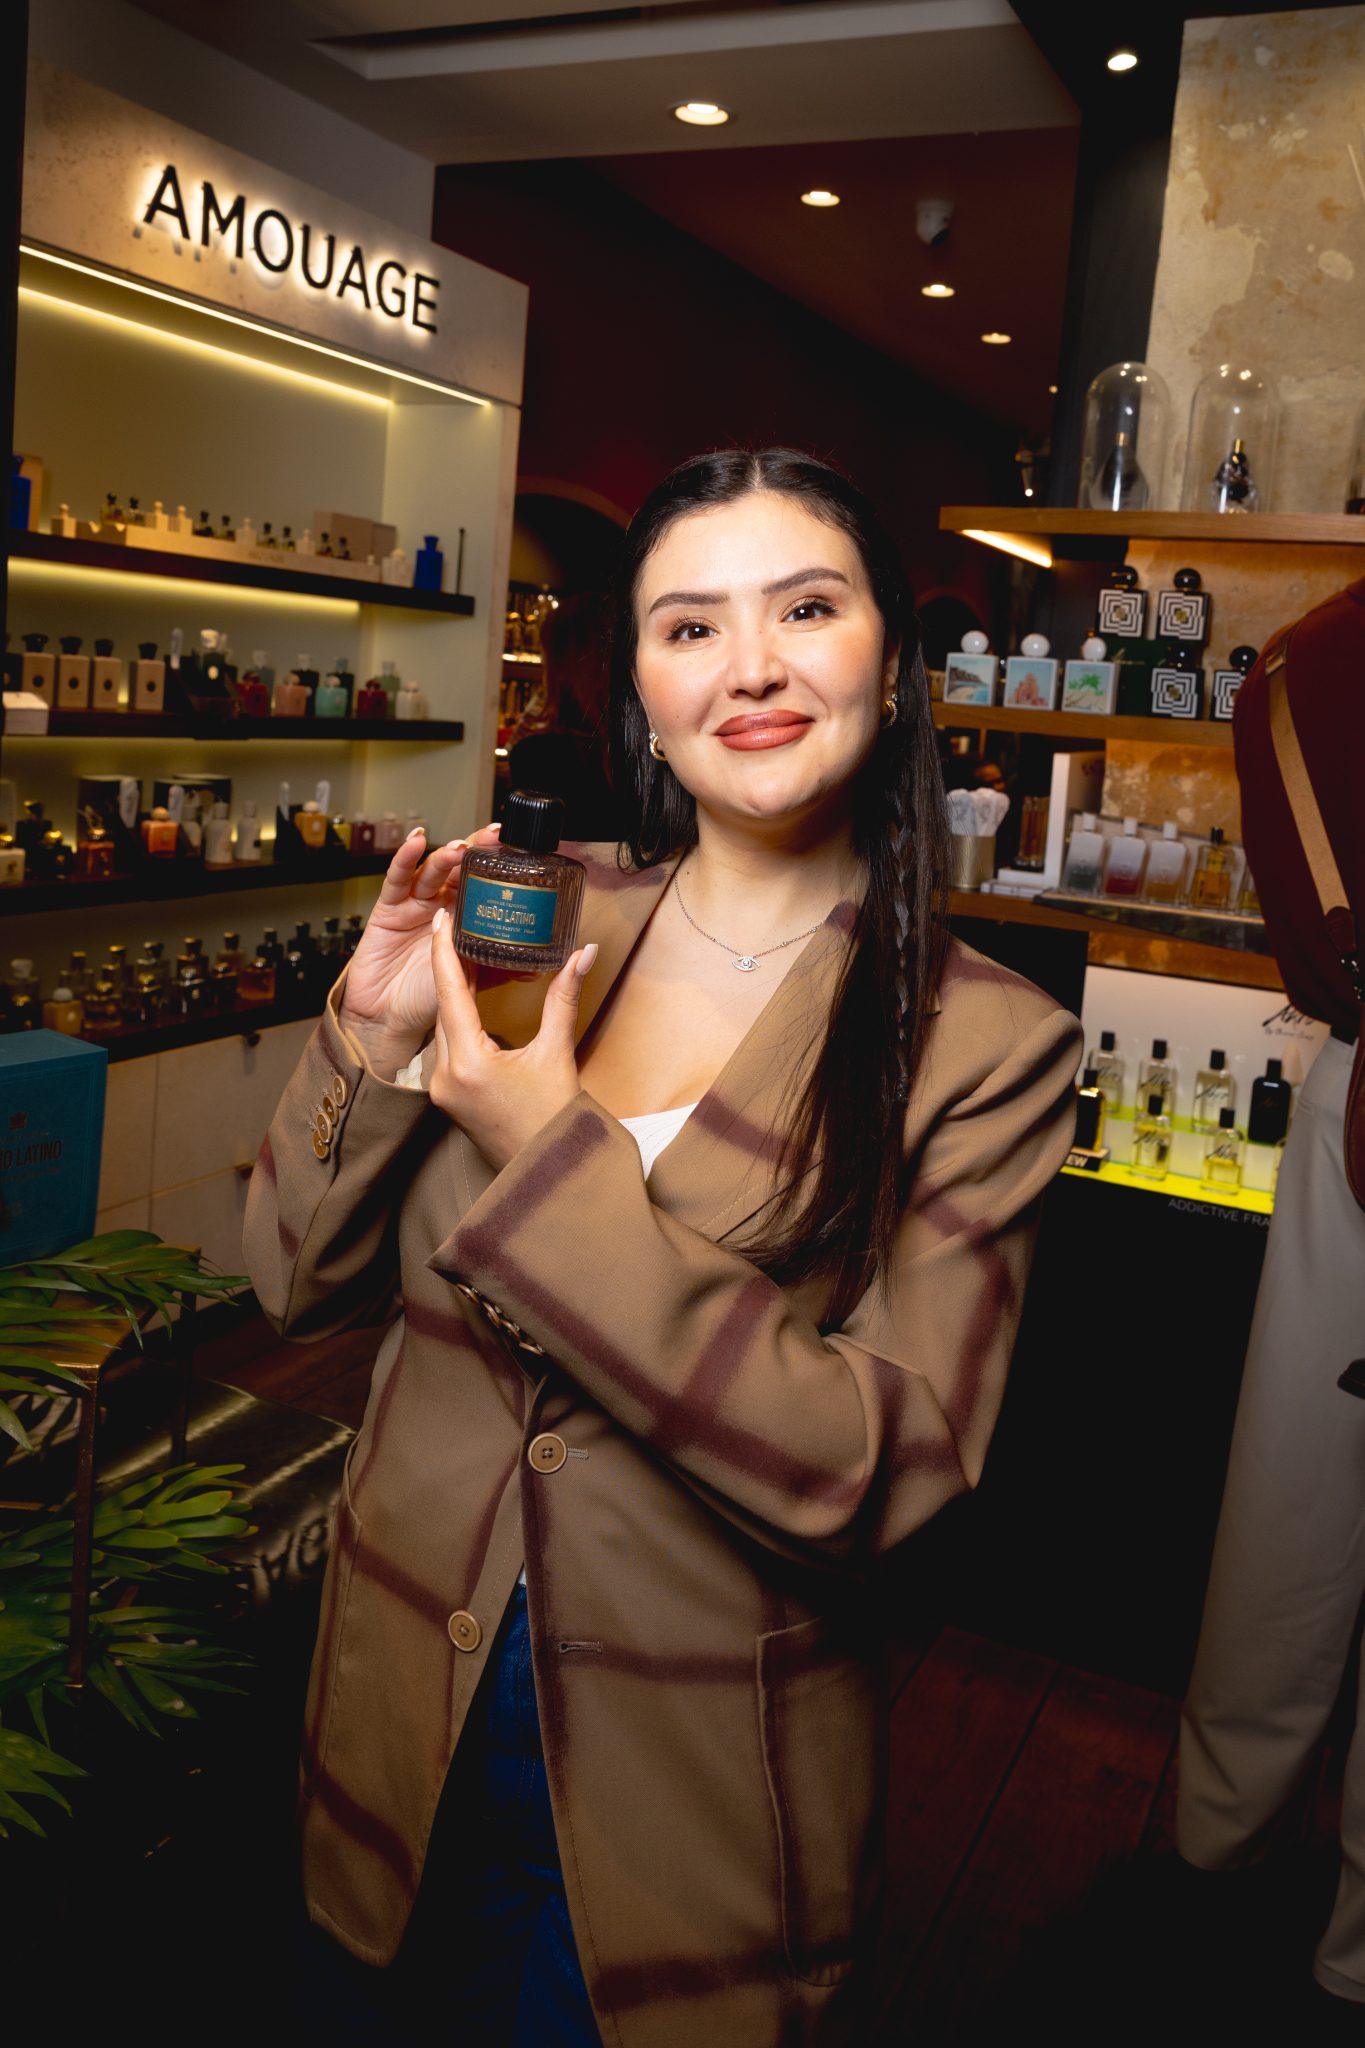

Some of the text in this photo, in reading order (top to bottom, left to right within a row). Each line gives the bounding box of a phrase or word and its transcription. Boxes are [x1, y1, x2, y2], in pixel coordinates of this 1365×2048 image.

[142, 164, 441, 334] AMOUAGE
[476, 904, 536, 925] SUEÑO LATINO
[15, 1139, 64, 1168] LATINO
[1167, 1197, 1239, 1222] ADDICTIVE
